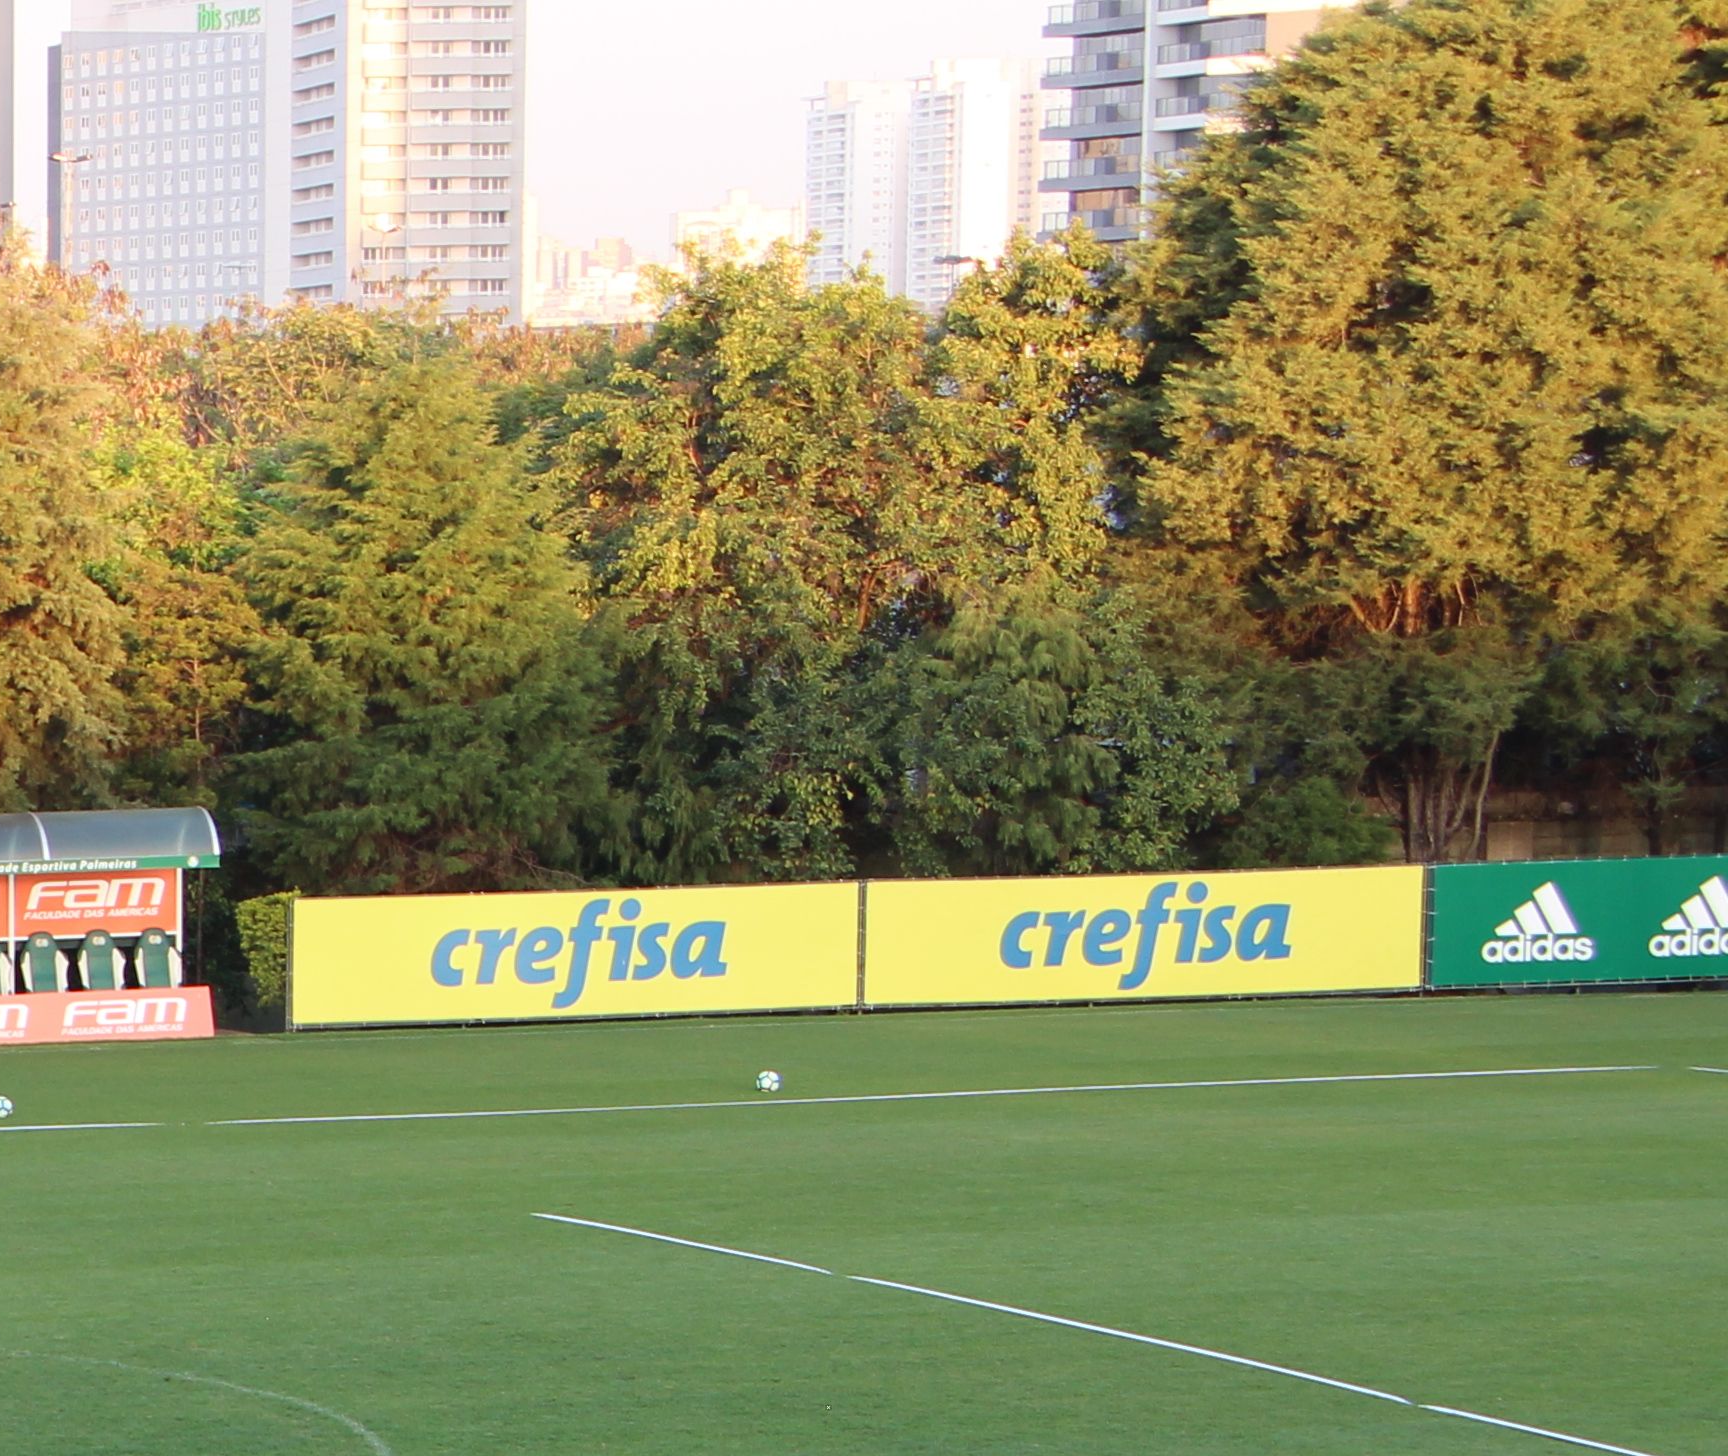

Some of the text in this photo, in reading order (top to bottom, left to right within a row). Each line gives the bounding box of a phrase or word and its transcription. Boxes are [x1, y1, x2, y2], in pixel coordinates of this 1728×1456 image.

[197, 3, 222, 32] ibis
[21, 861, 77, 874] Esportiva
[79, 859, 137, 871] Palmeiras
[83, 909, 105, 918] DAS
[1000, 881, 1292, 991] crefisa
[1481, 933, 1595, 963] adidas
[430, 898, 728, 1009] crefisa
